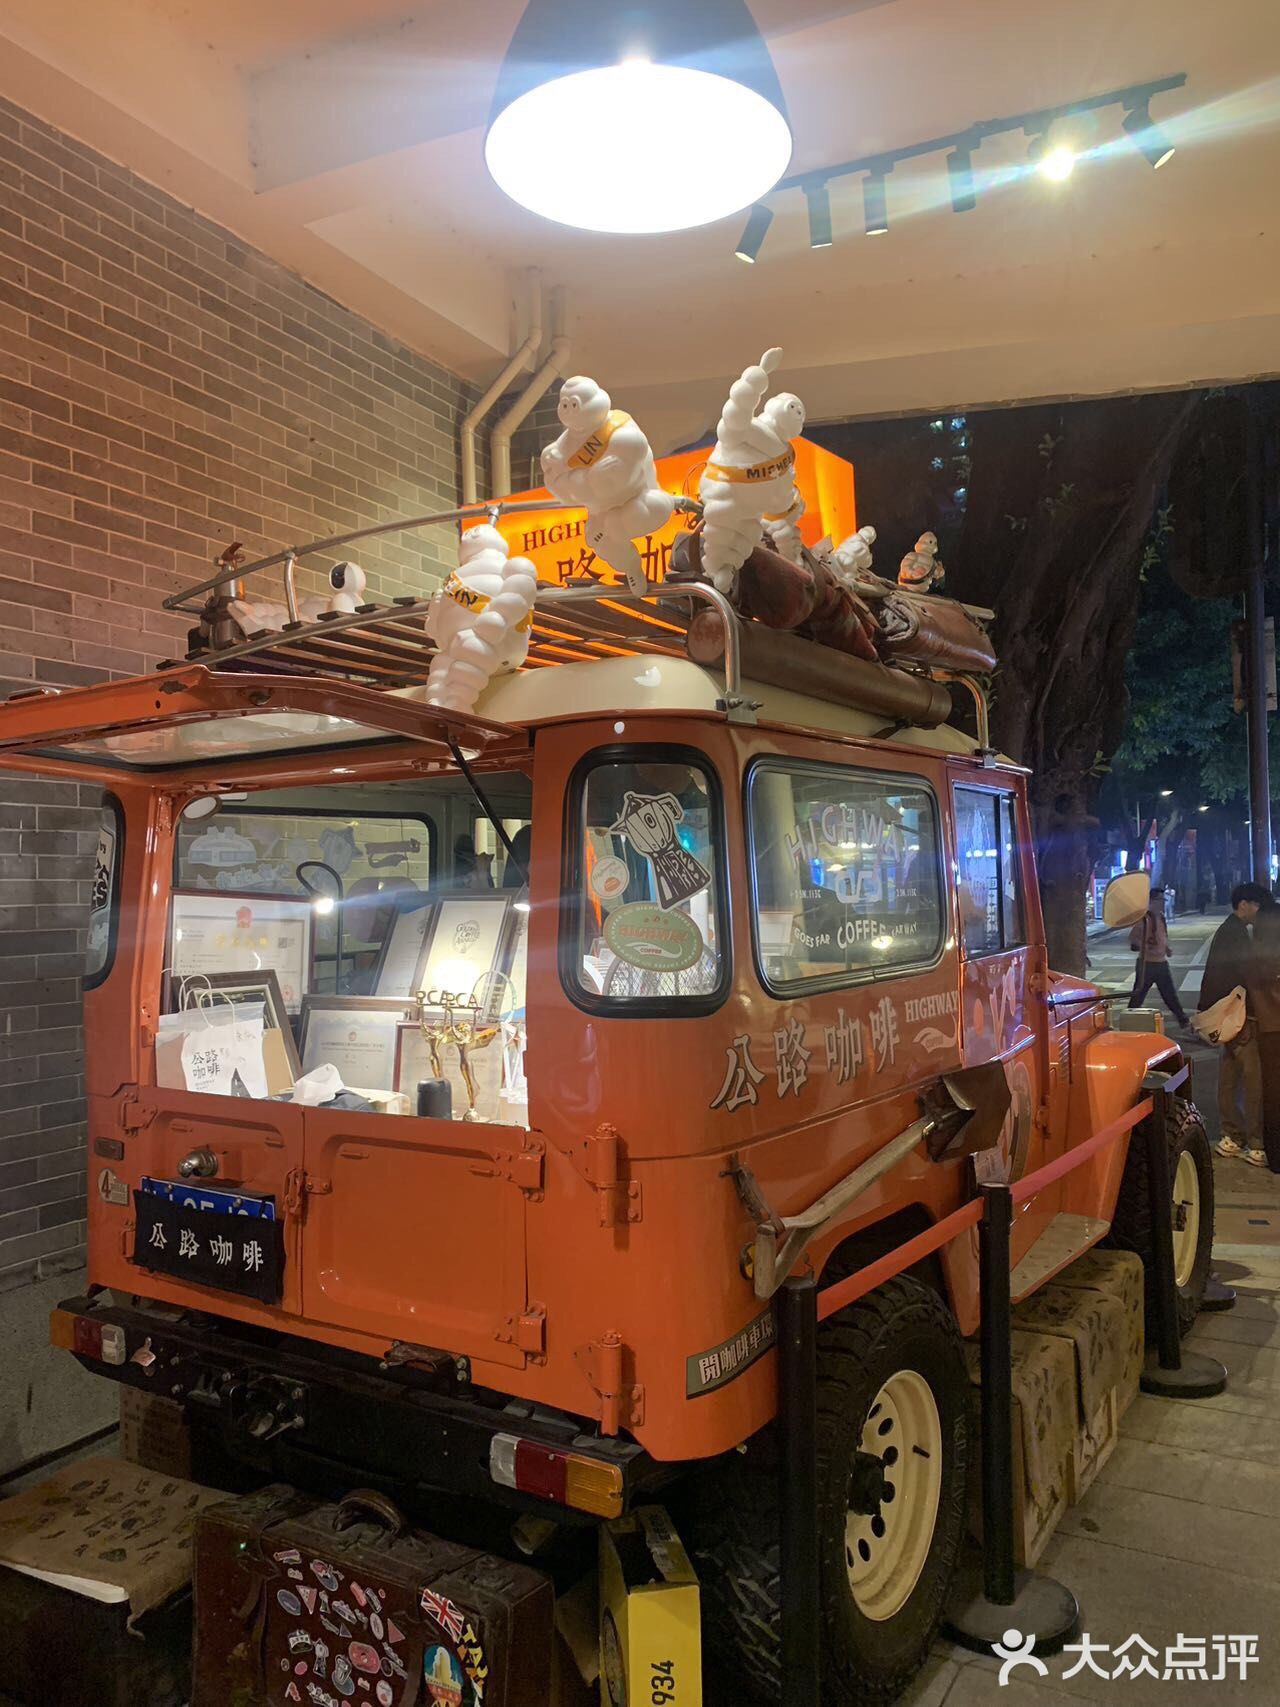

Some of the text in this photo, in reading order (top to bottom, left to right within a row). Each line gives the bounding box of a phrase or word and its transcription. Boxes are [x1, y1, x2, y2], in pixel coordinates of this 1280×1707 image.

[522, 519, 587, 552] HIGH
[837, 919, 887, 949] COFFEE
[904, 990, 959, 1023] HIGHWAY
[710, 996, 901, 1113] 公路咖啡
[148, 1222, 264, 1272] 公路咖啡
